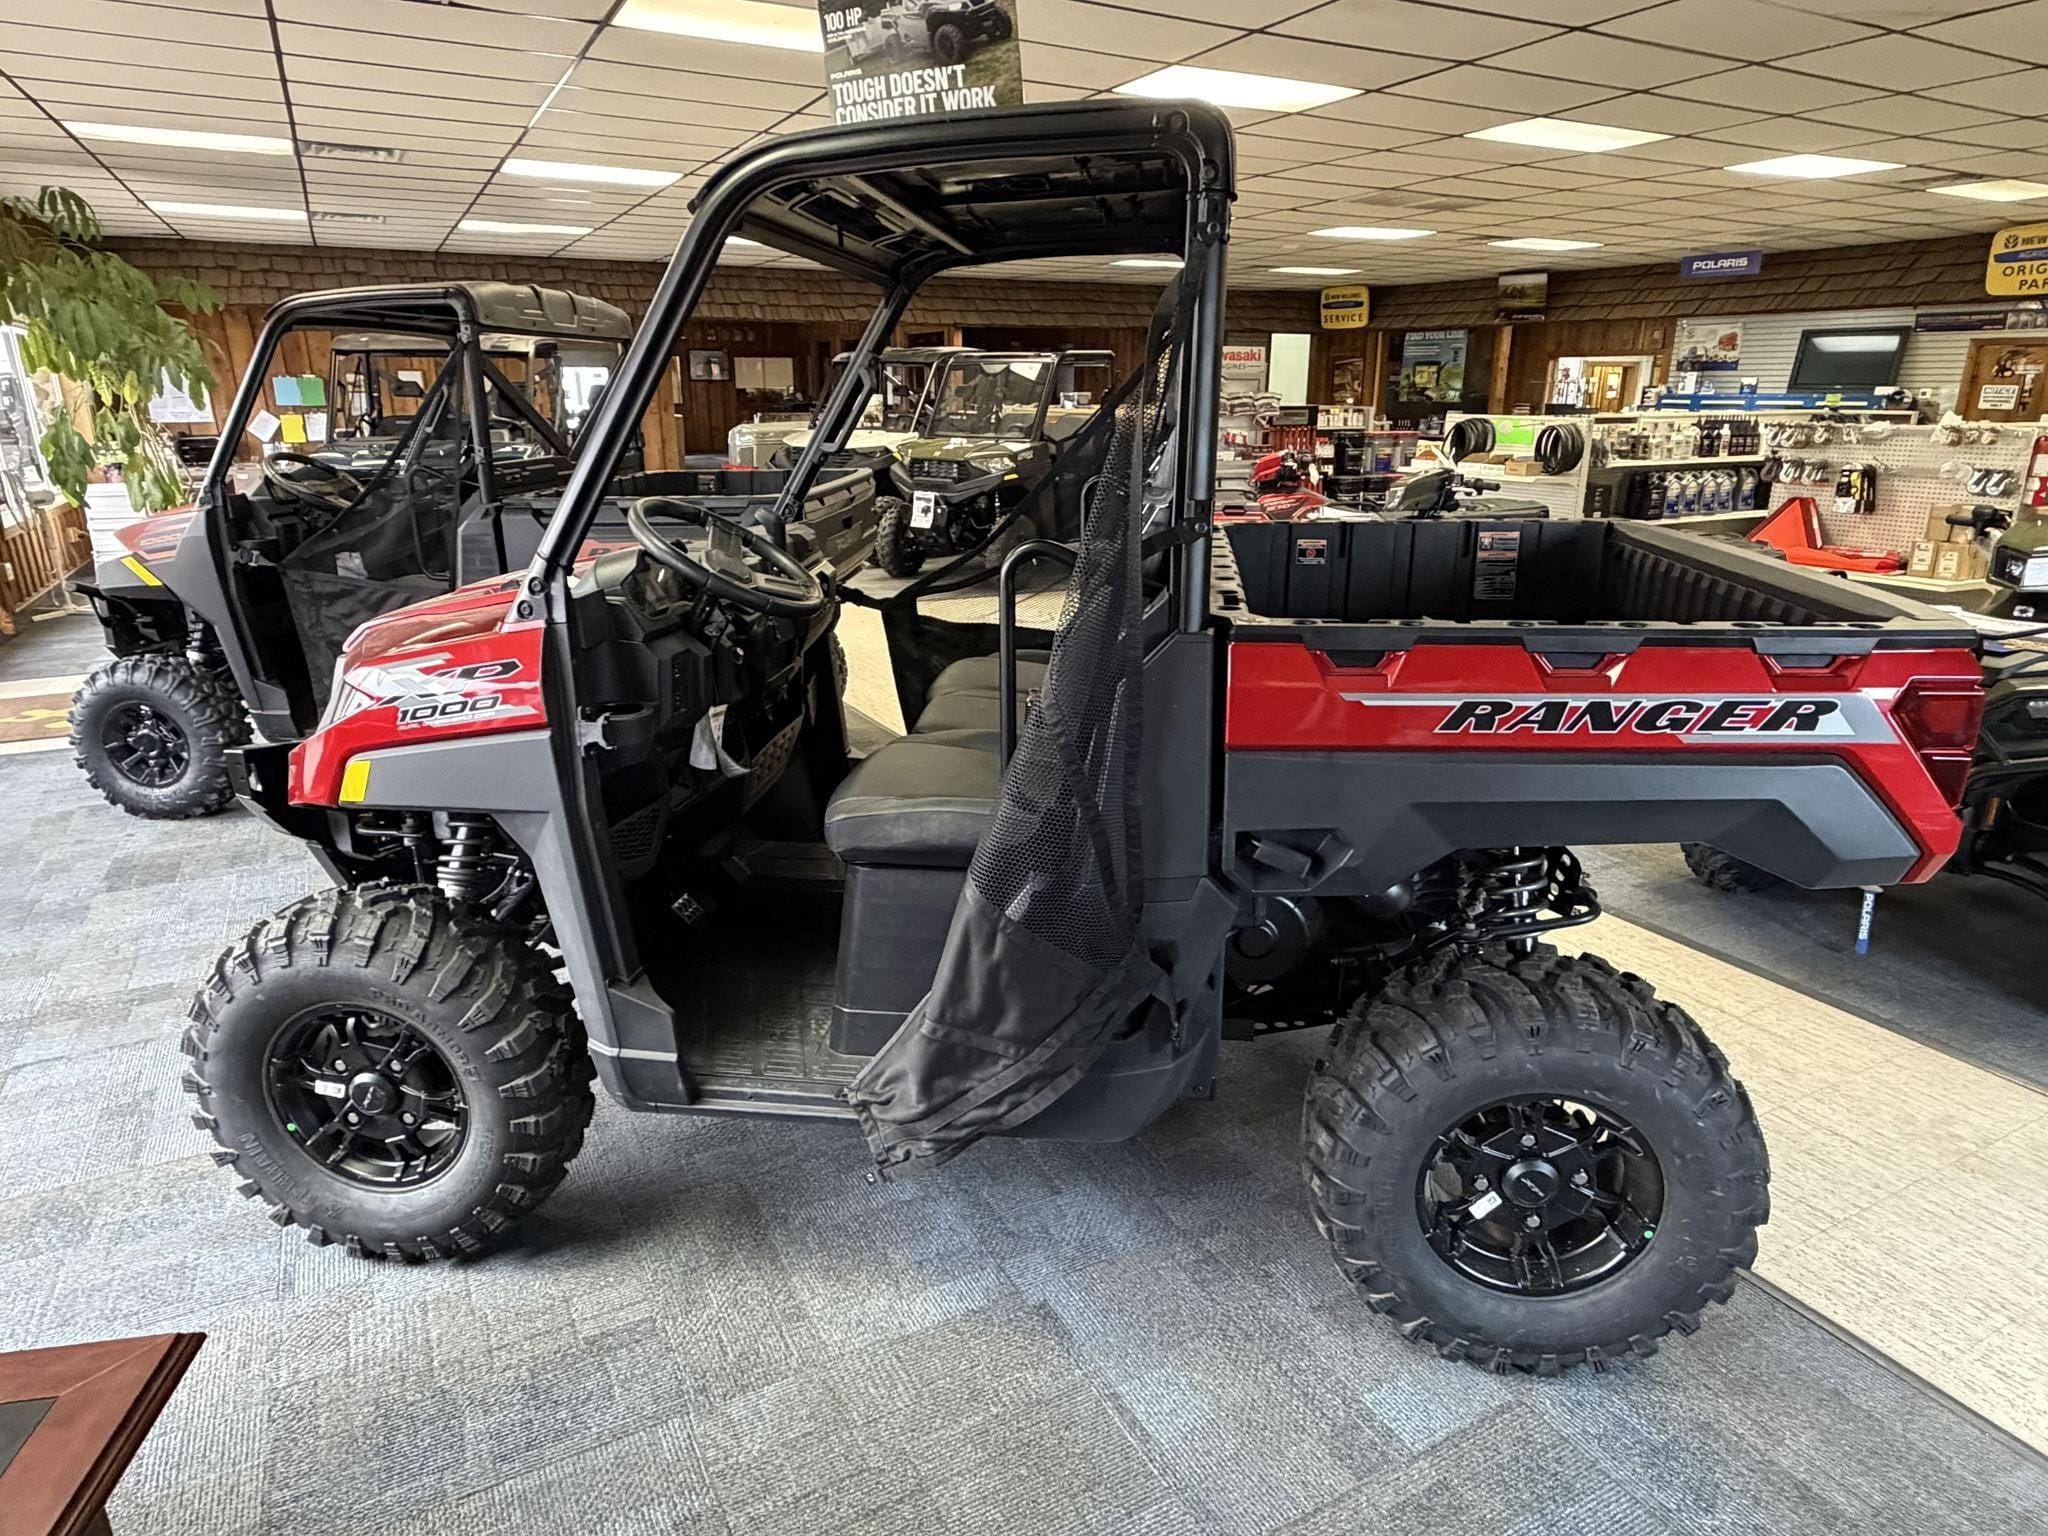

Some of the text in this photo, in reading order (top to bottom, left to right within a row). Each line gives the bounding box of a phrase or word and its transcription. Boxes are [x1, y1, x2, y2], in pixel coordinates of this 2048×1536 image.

[824, 7, 863, 32] 100 HP
[832, 64, 966, 107] TOUGH DOESN'T
[836, 85, 997, 125] CONSIDER IT WORK
[1692, 257, 1749, 271] POLARIS
[1323, 313, 1364, 323] SERVICE
[398, 694, 501, 723] 1000
[1434, 698, 1841, 735] RANGER
[1858, 893, 1875, 940] POLARIS
